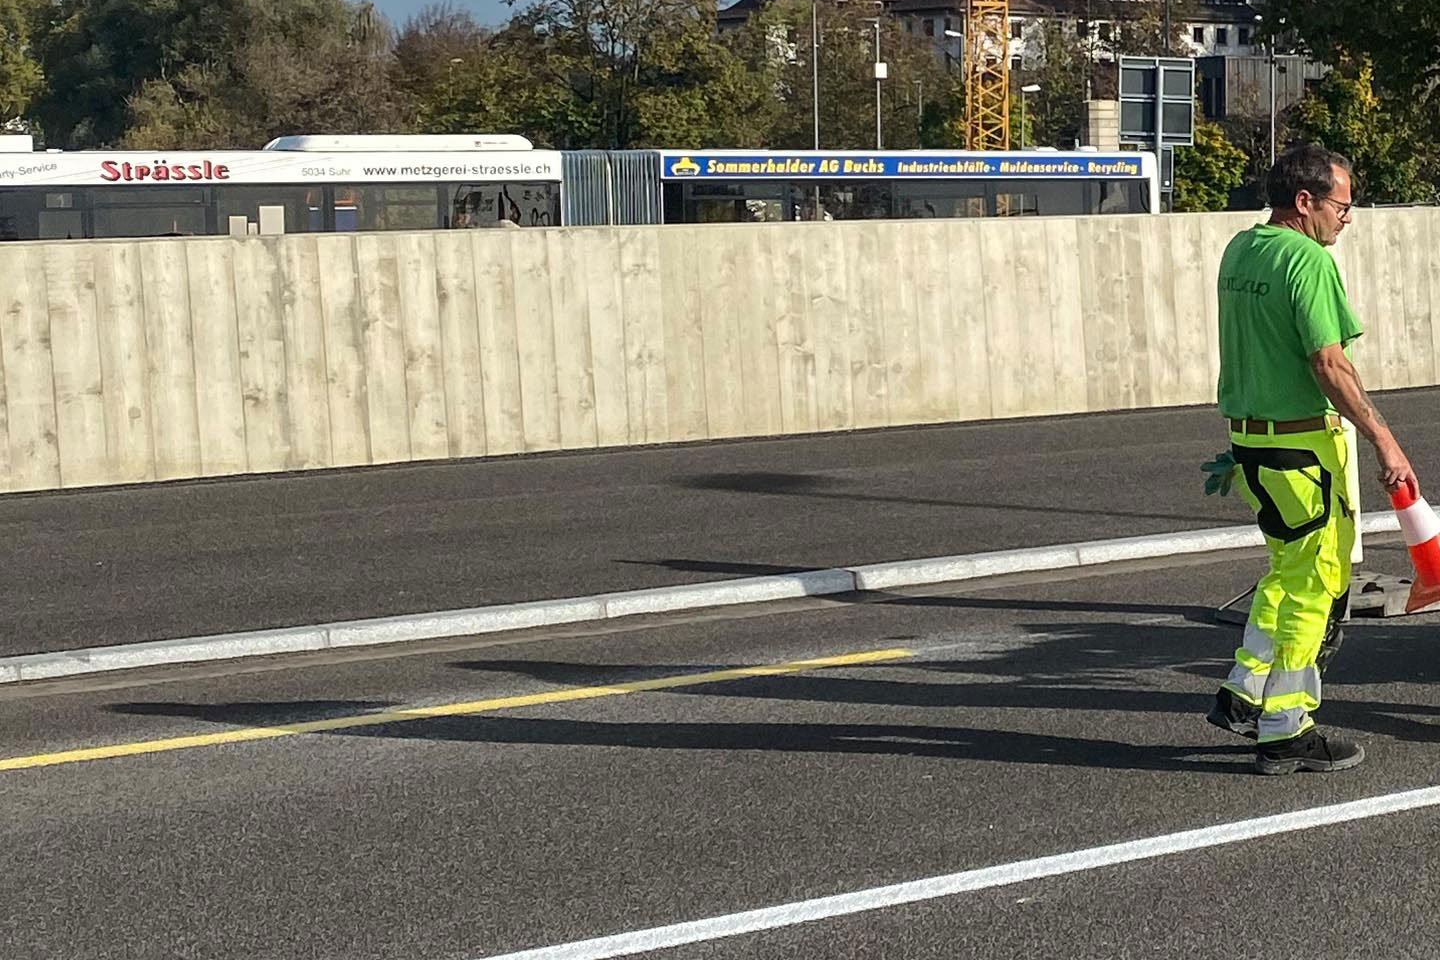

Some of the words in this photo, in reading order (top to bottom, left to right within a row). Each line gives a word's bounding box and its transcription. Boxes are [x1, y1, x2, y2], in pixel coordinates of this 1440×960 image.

[100, 159, 230, 181] Strässle
[301, 167, 326, 177] 5034
[328, 166, 351, 176] Suhr
[363, 164, 551, 178] www.metzgerei-straessle.ch
[707, 158, 816, 173] Sommerhalder
[818, 159, 839, 173] AG
[843, 159, 885, 173] Buchs
[1087, 160, 1138, 175] Recycling
